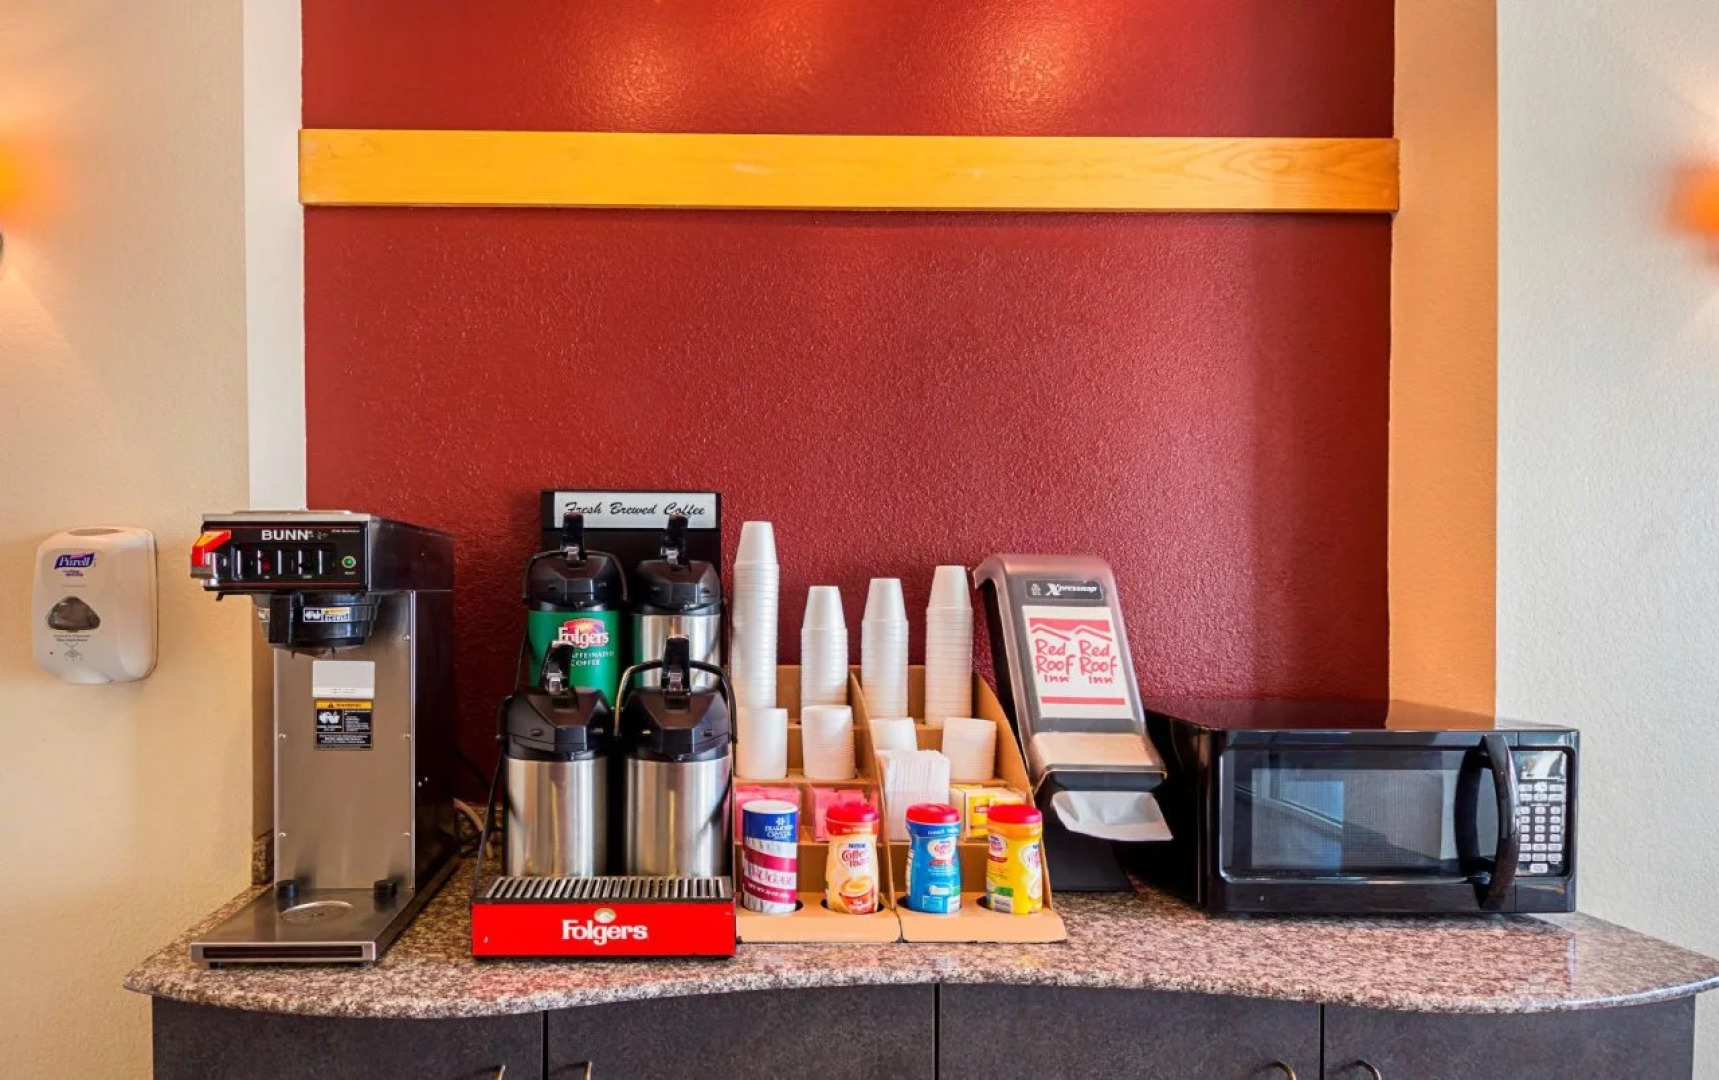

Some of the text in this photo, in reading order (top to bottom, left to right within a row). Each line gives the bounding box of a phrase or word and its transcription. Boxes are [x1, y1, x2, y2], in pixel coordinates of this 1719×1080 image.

[565, 502, 705, 517] Fresh Brewed Coffee
[261, 529, 309, 541] BUNN
[558, 627, 609, 649] Folgers
[1035, 638, 1066, 656] Red
[1079, 639, 1111, 657] Red
[1036, 654, 1077, 675] Roof
[1079, 655, 1118, 677] Roof
[562, 919, 648, 945] Folgers
